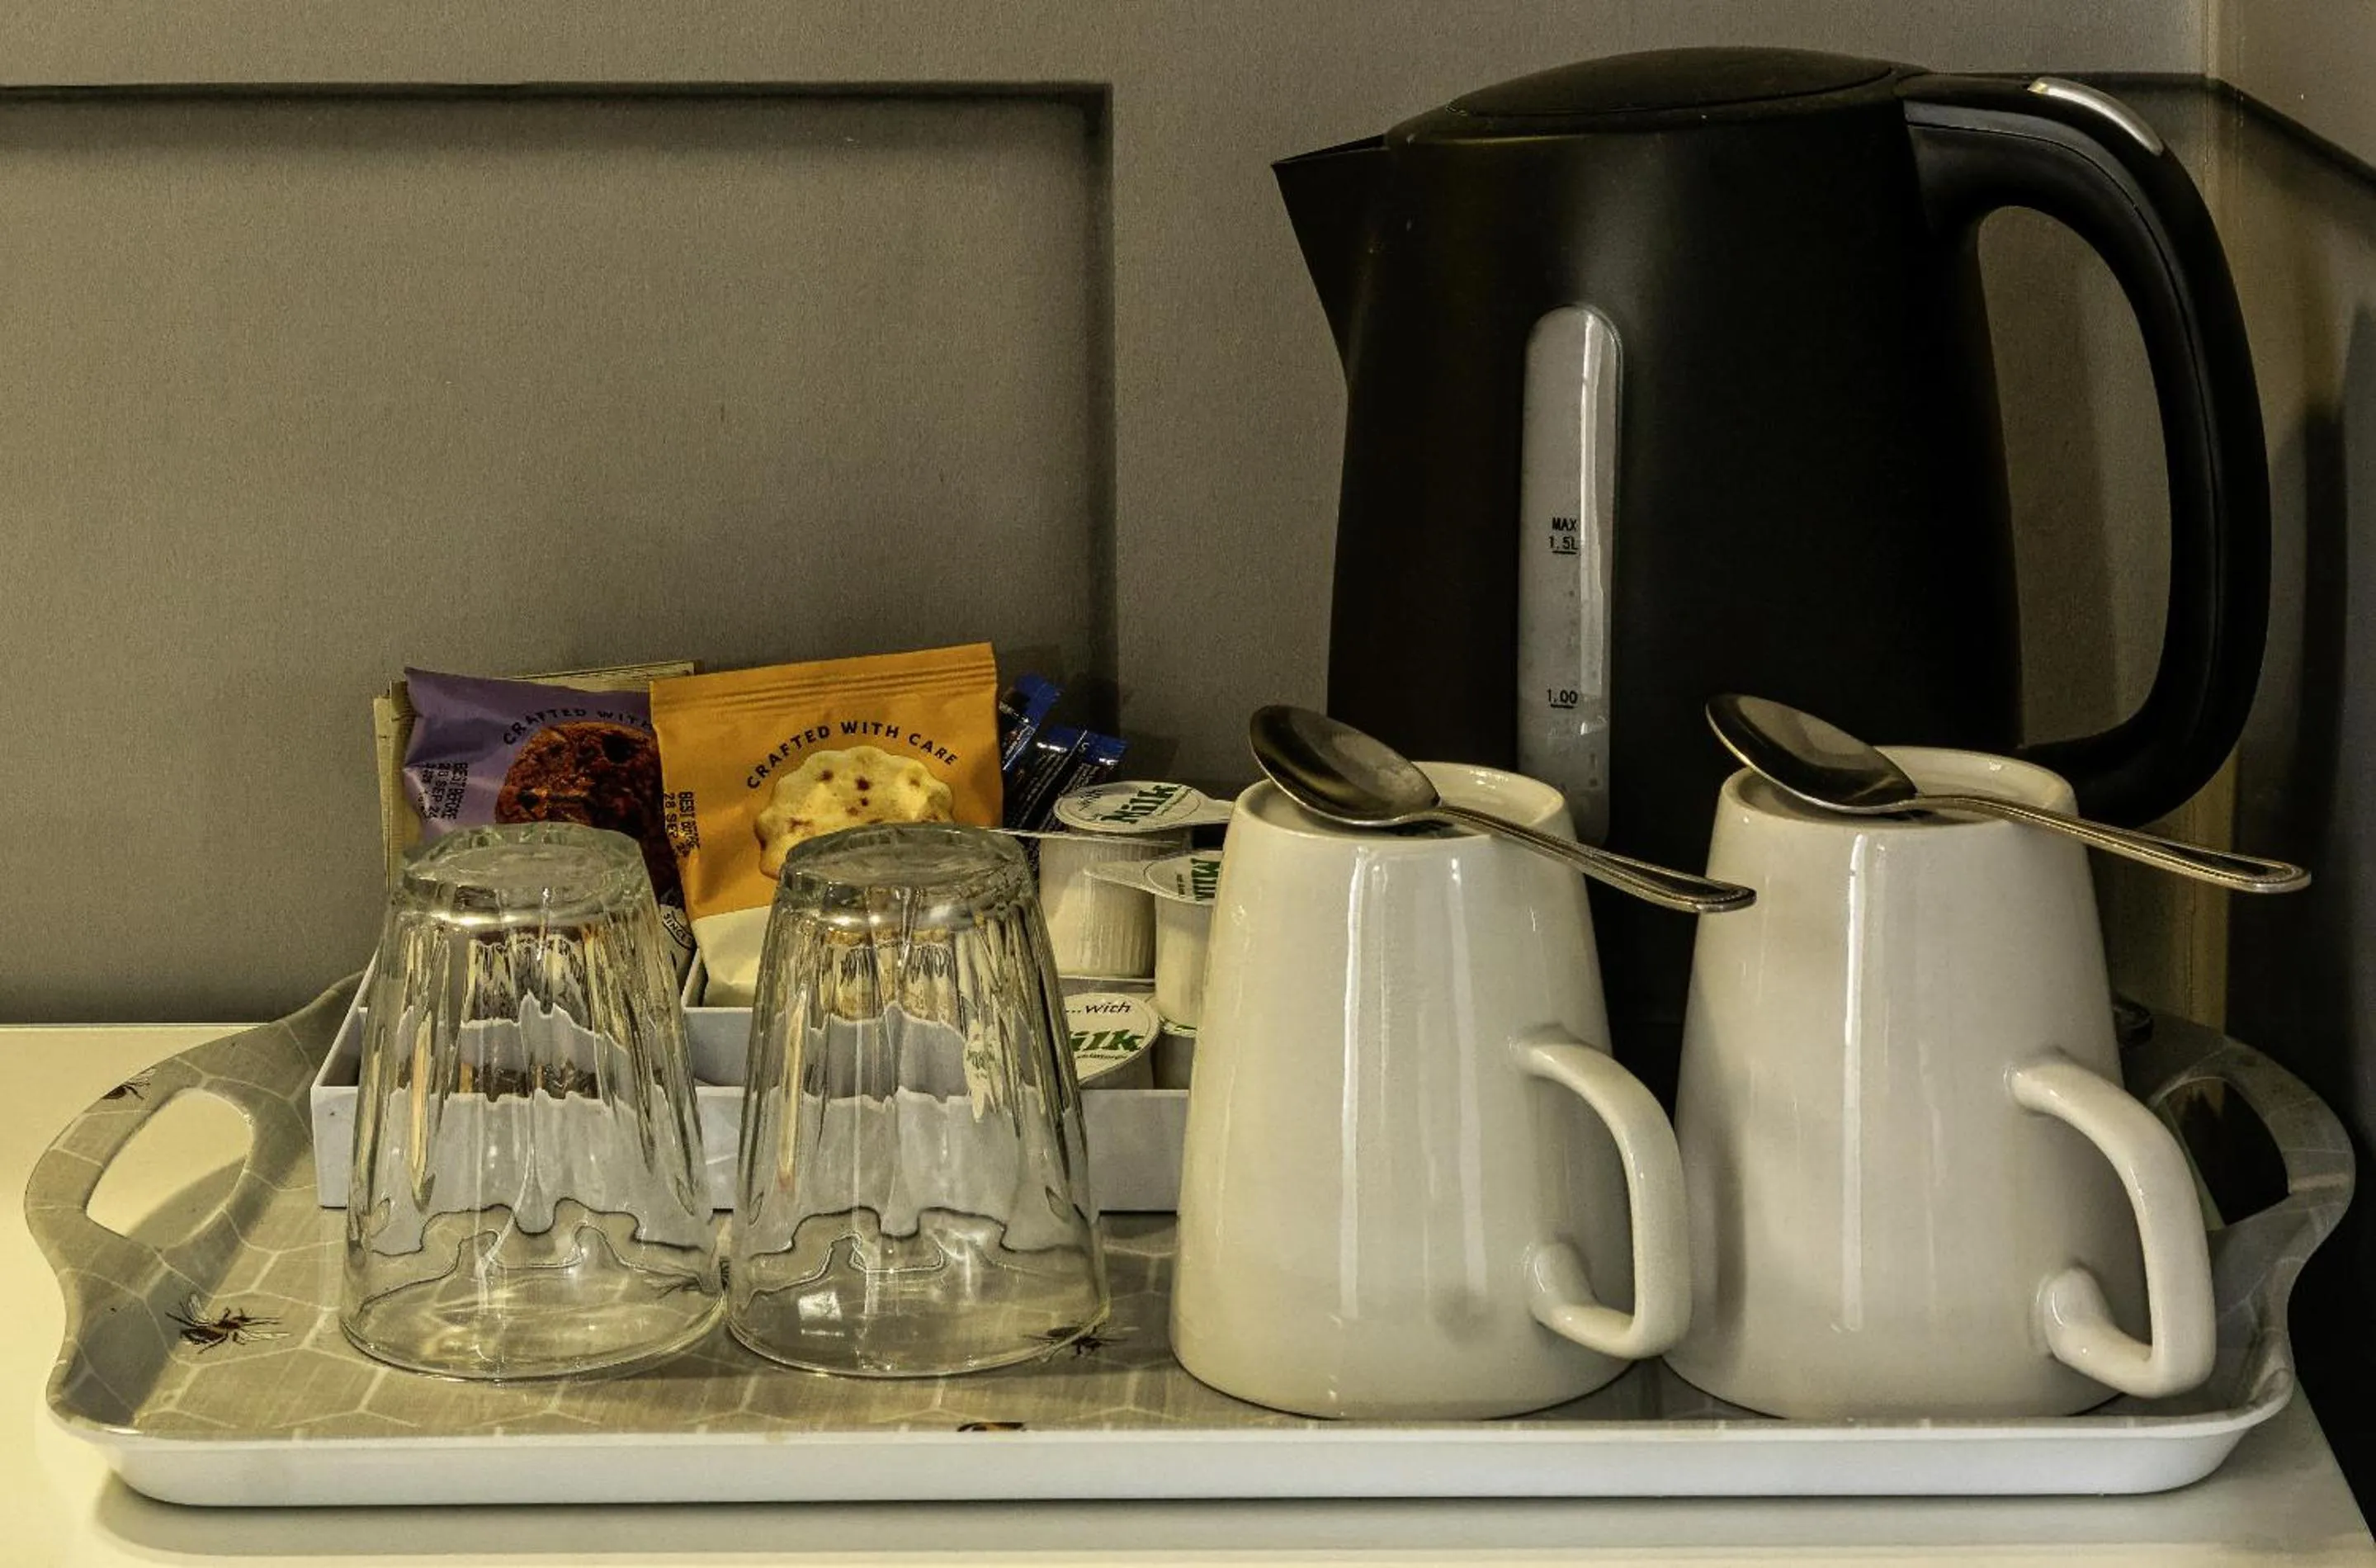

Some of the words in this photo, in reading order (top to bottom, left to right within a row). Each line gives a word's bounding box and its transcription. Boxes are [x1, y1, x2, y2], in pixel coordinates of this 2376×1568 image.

[1552, 517, 1577, 531] MAX
[1548, 536, 1579, 550] 1.5L
[1547, 688, 1578, 704] 1.00
[503, 709, 587, 744] CRAFTED
[598, 711, 653, 731] WITH
[747, 725, 829, 789] CRAFTED
[840, 720, 900, 739] WITH
[909, 733, 957, 765] CARE
[664, 792, 676, 808] 28
[678, 791, 695, 819] BEST
[1101, 785, 1179, 824] Milk
[1069, 1028, 1145, 1052] ilk
